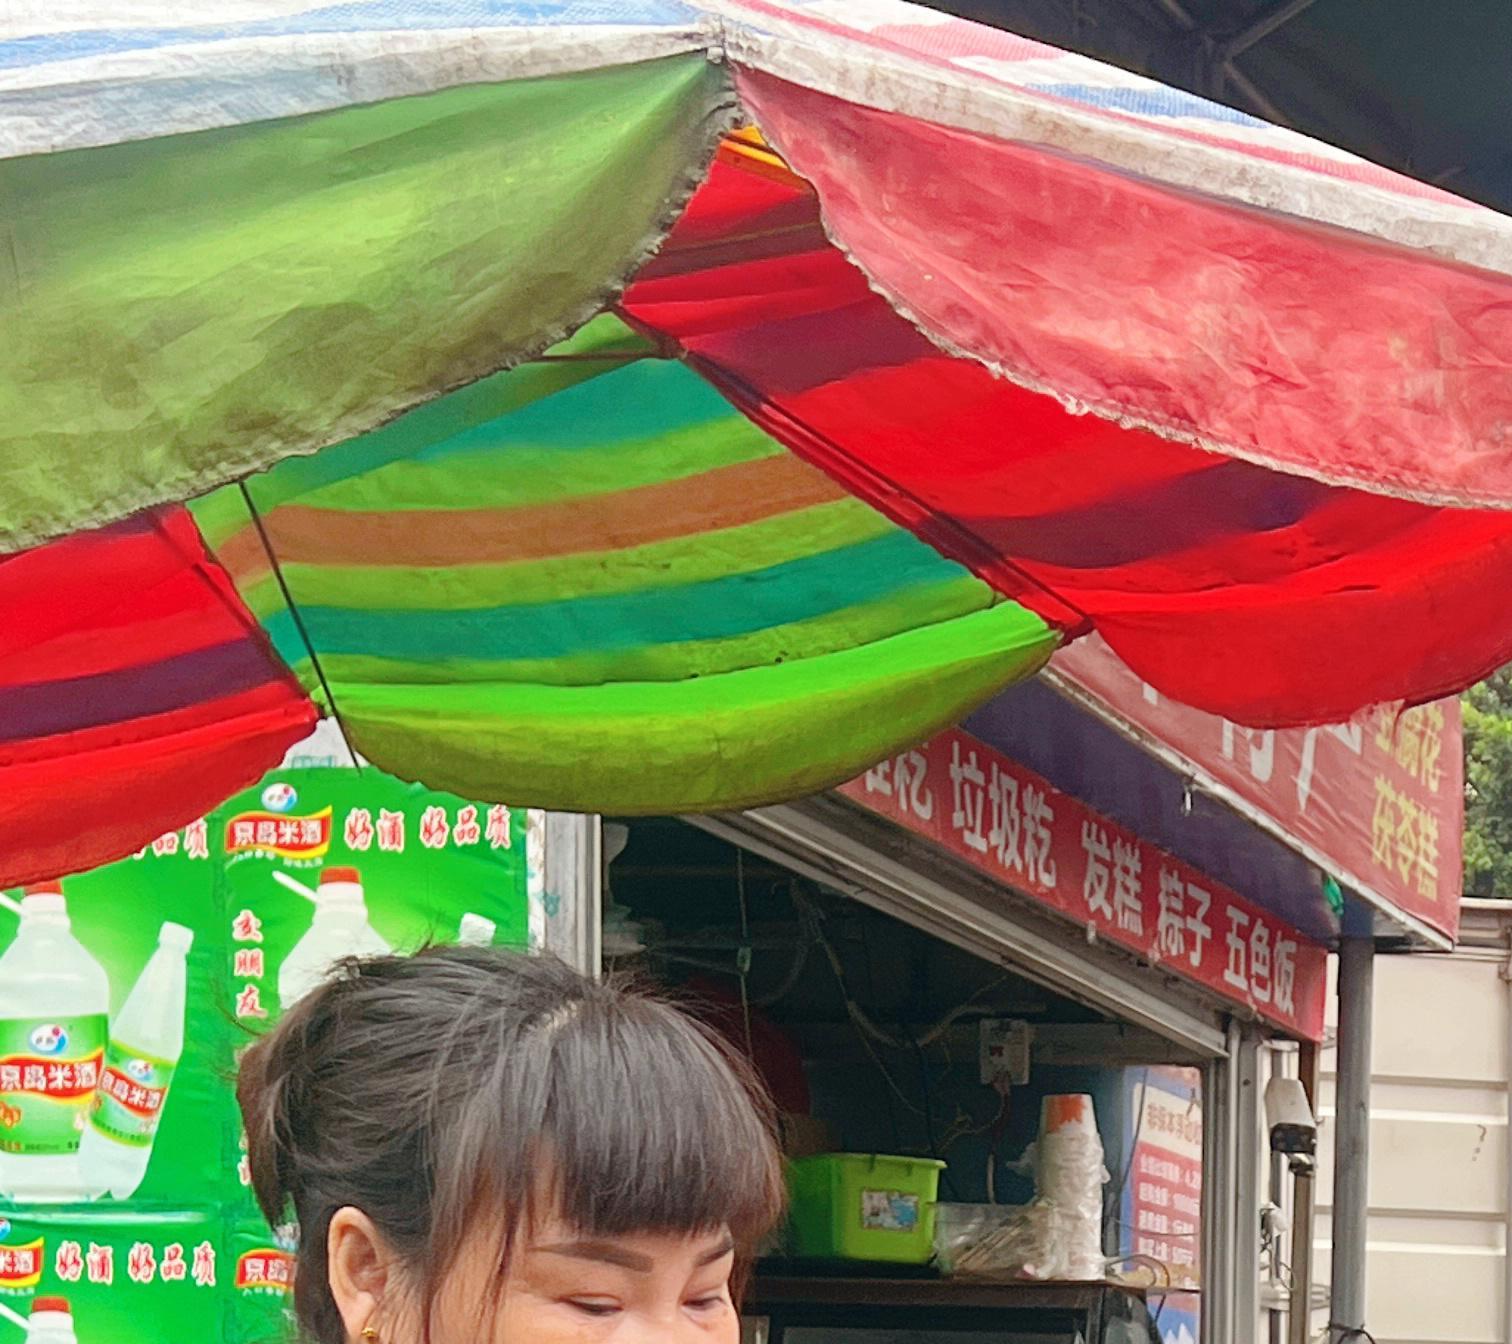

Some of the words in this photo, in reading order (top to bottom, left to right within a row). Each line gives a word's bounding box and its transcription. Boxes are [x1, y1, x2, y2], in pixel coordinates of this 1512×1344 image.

[131, 817, 209, 860] 品质
[344, 806, 405, 853] 好酒
[419, 803, 512, 850] 好品质
[1081, 818, 1143, 937] 发糕
[1156, 865, 1211, 968] 粽子
[1223, 904, 1297, 1017] 五色饭
[55, 1240, 113, 1286] 好酒
[128, 1240, 216, 1287] 好品质
